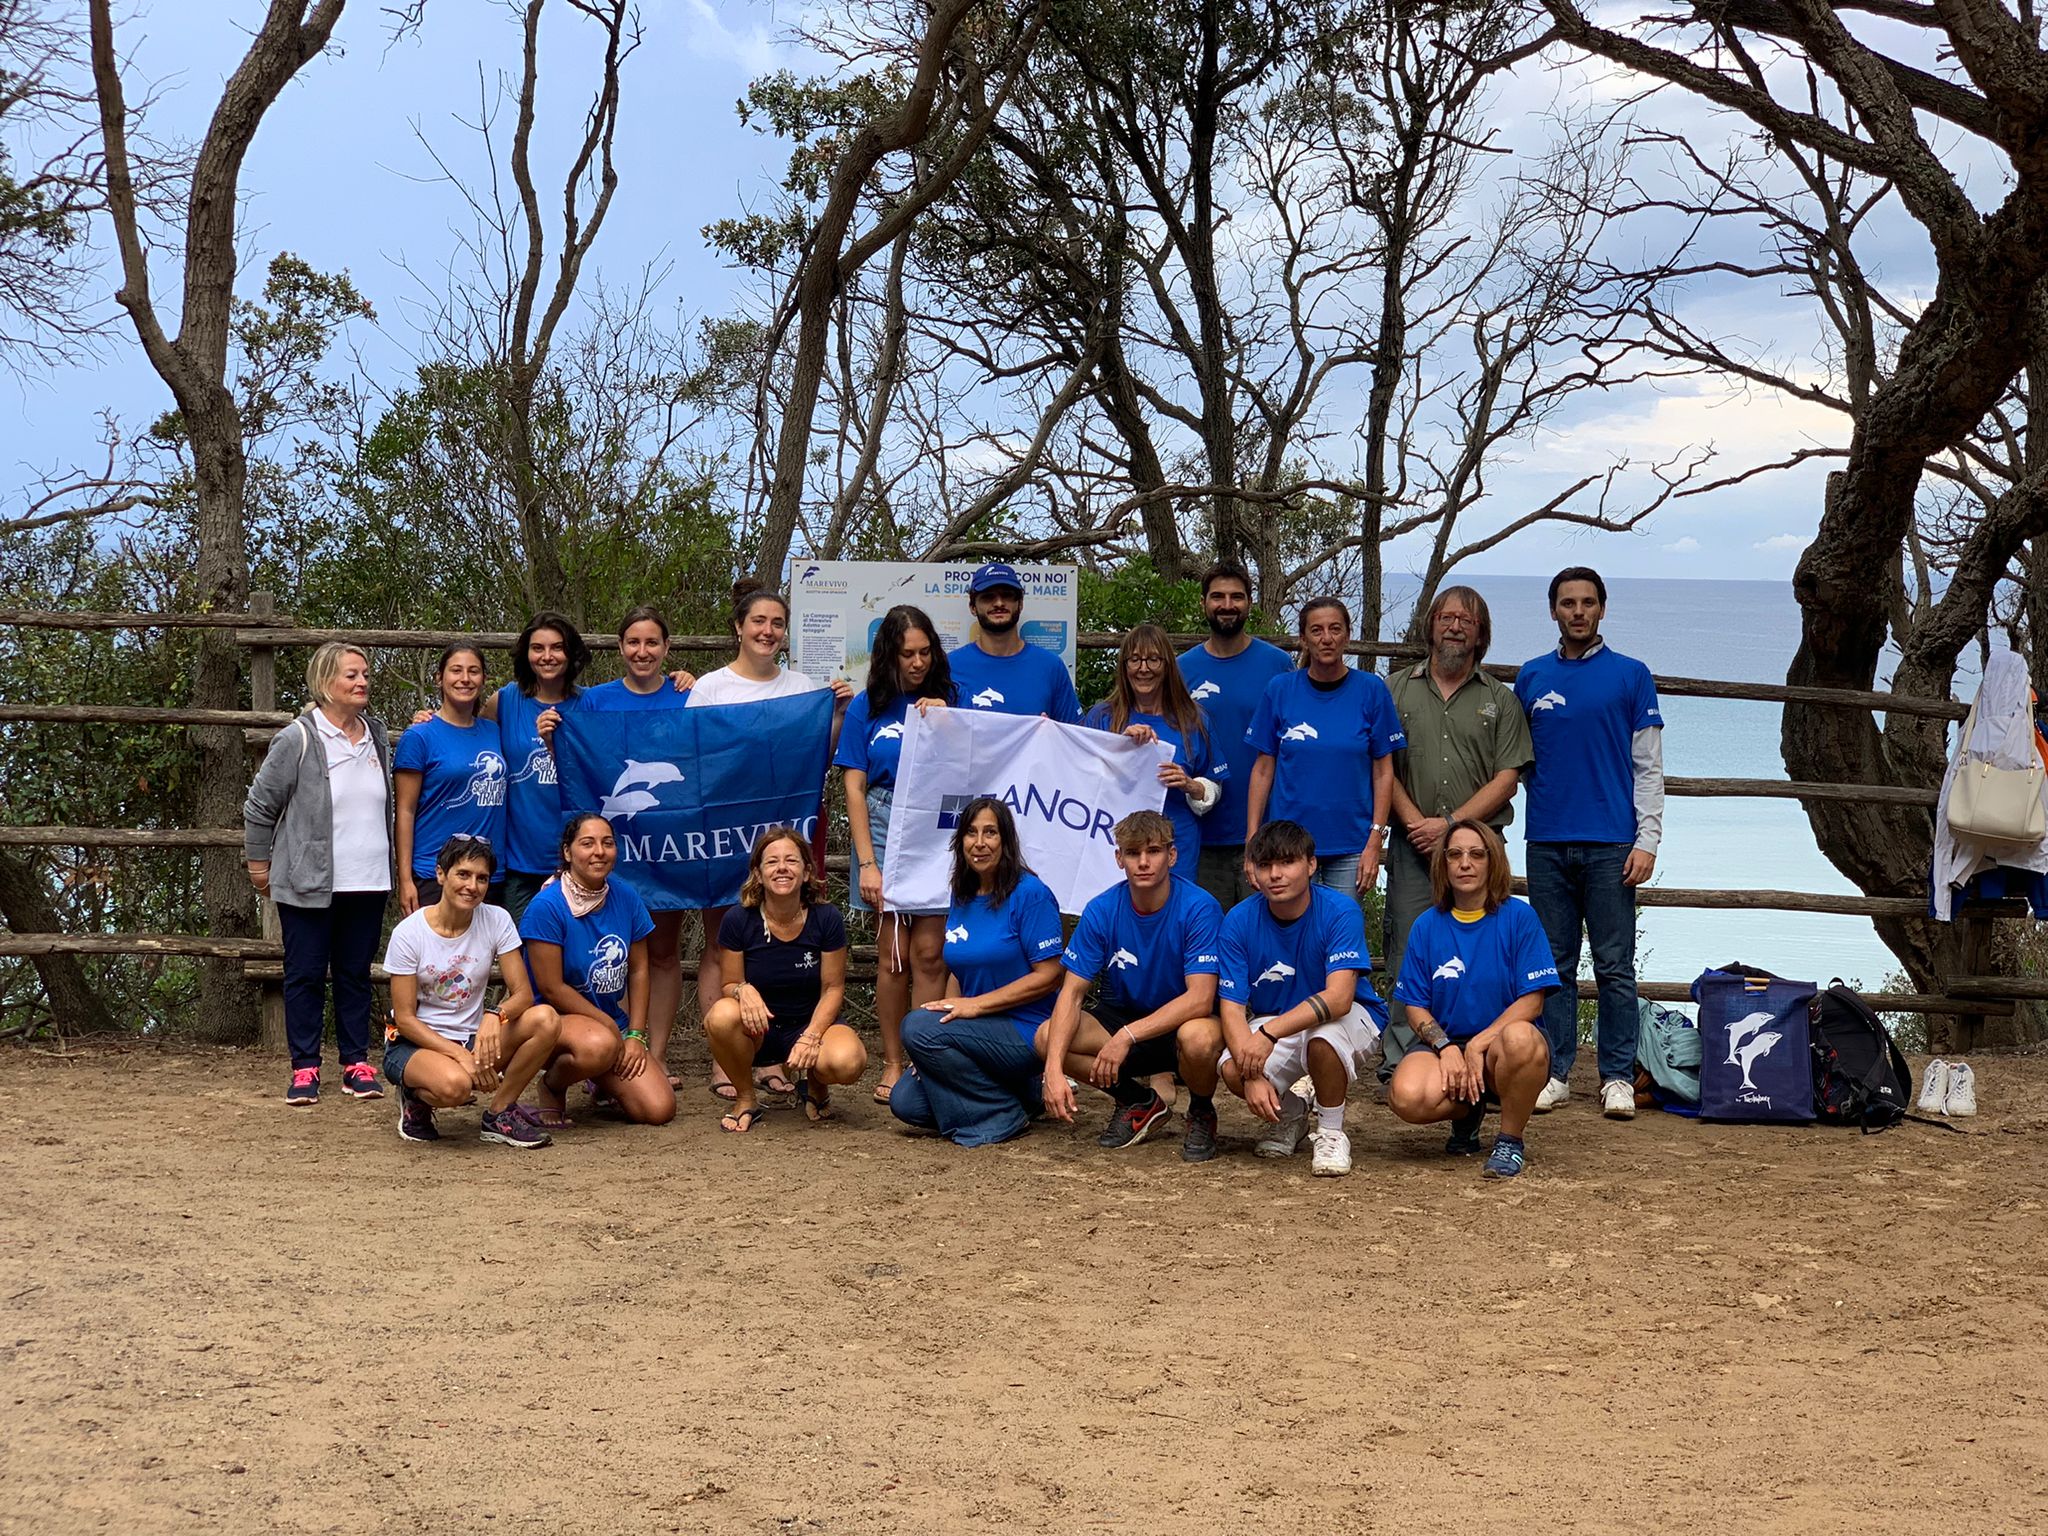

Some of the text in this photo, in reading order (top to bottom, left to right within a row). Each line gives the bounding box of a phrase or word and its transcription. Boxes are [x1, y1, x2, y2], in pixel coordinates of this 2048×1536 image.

[806, 580, 848, 588] MAREVIVO
[944, 571, 975, 581] PROT
[1045, 573, 1067, 584] NOI
[925, 583, 940, 594] LA
[944, 583, 970, 594] SPIA
[1033, 585, 1067, 596] MARE
[981, 783, 1115, 846] ANOR
